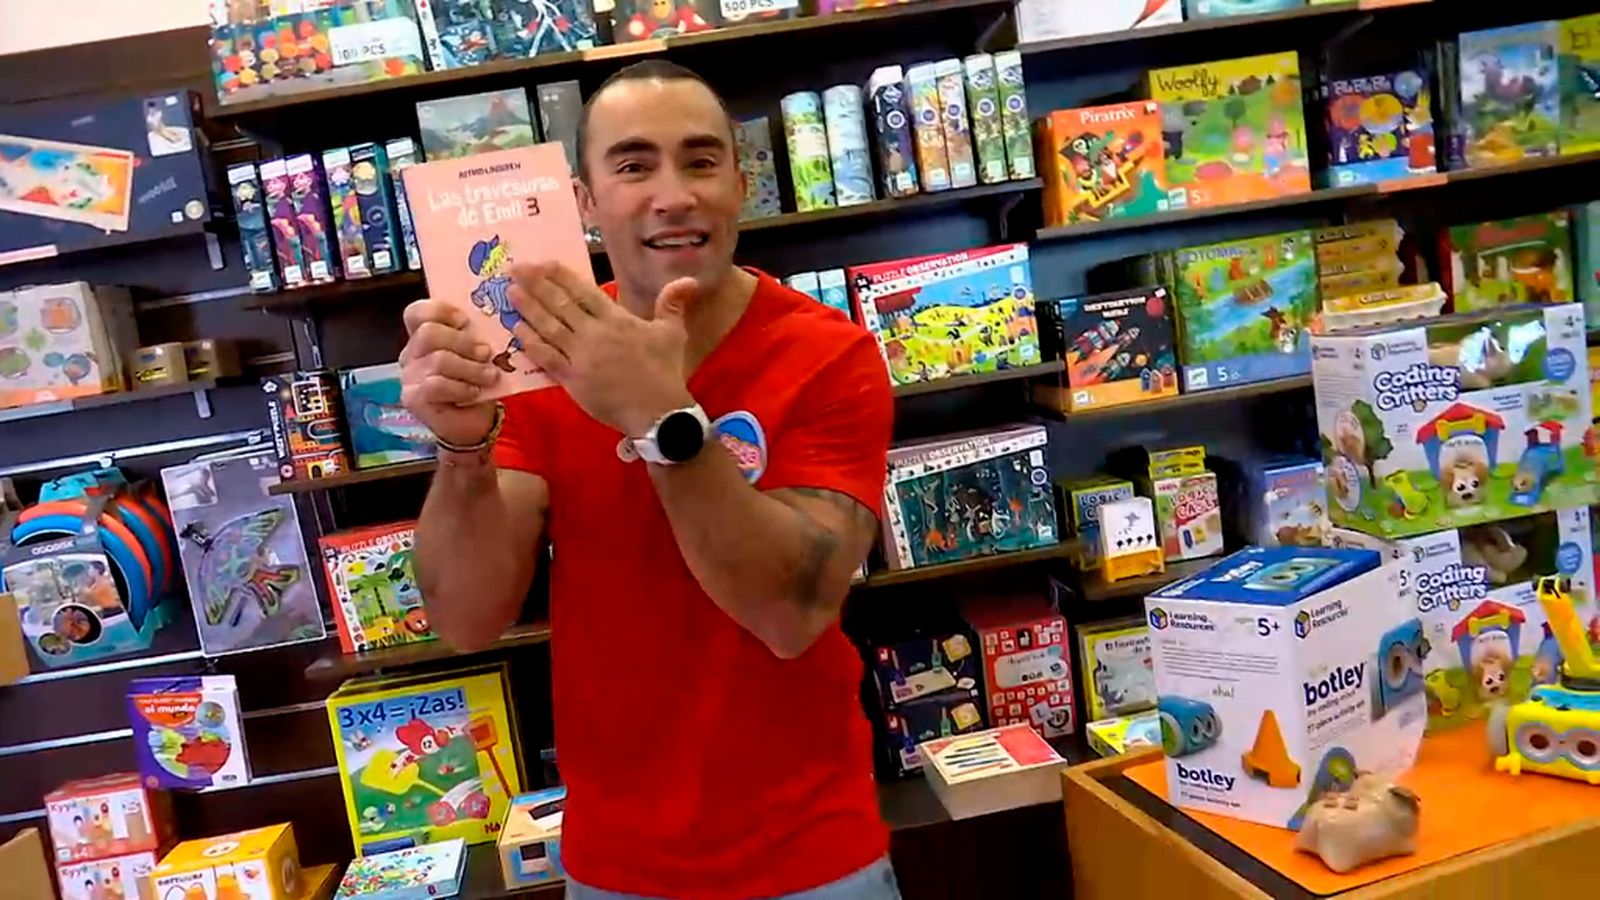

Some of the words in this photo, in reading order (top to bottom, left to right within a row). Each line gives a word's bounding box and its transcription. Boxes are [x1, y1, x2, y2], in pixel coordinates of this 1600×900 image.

[1156, 69, 1219, 97] Woolfy
[1080, 106, 1136, 125] Piratrix
[428, 188, 464, 212] Las
[464, 175, 560, 201] travesuras
[458, 208, 479, 227] de
[483, 201, 522, 224] Emil
[526, 197, 540, 217] 3
[873, 268, 906, 284] PUZZLE
[906, 252, 969, 276] OBSERVATION
[1217, 366, 1229, 382] 5
[1375, 364, 1459, 393] Coding
[1377, 384, 1459, 411] Critters
[929, 437, 991, 460] OBSERVATION
[1416, 563, 1487, 593] Coding
[1310, 599, 1342, 618] Learning
[1417, 583, 1487, 613] Critters
[1169, 611, 1207, 623] Learning
[1257, 617, 1280, 637] 5+
[1303, 661, 1365, 707] botley
[157, 702, 196, 713] mundo
[1177, 763, 1236, 791] botley
